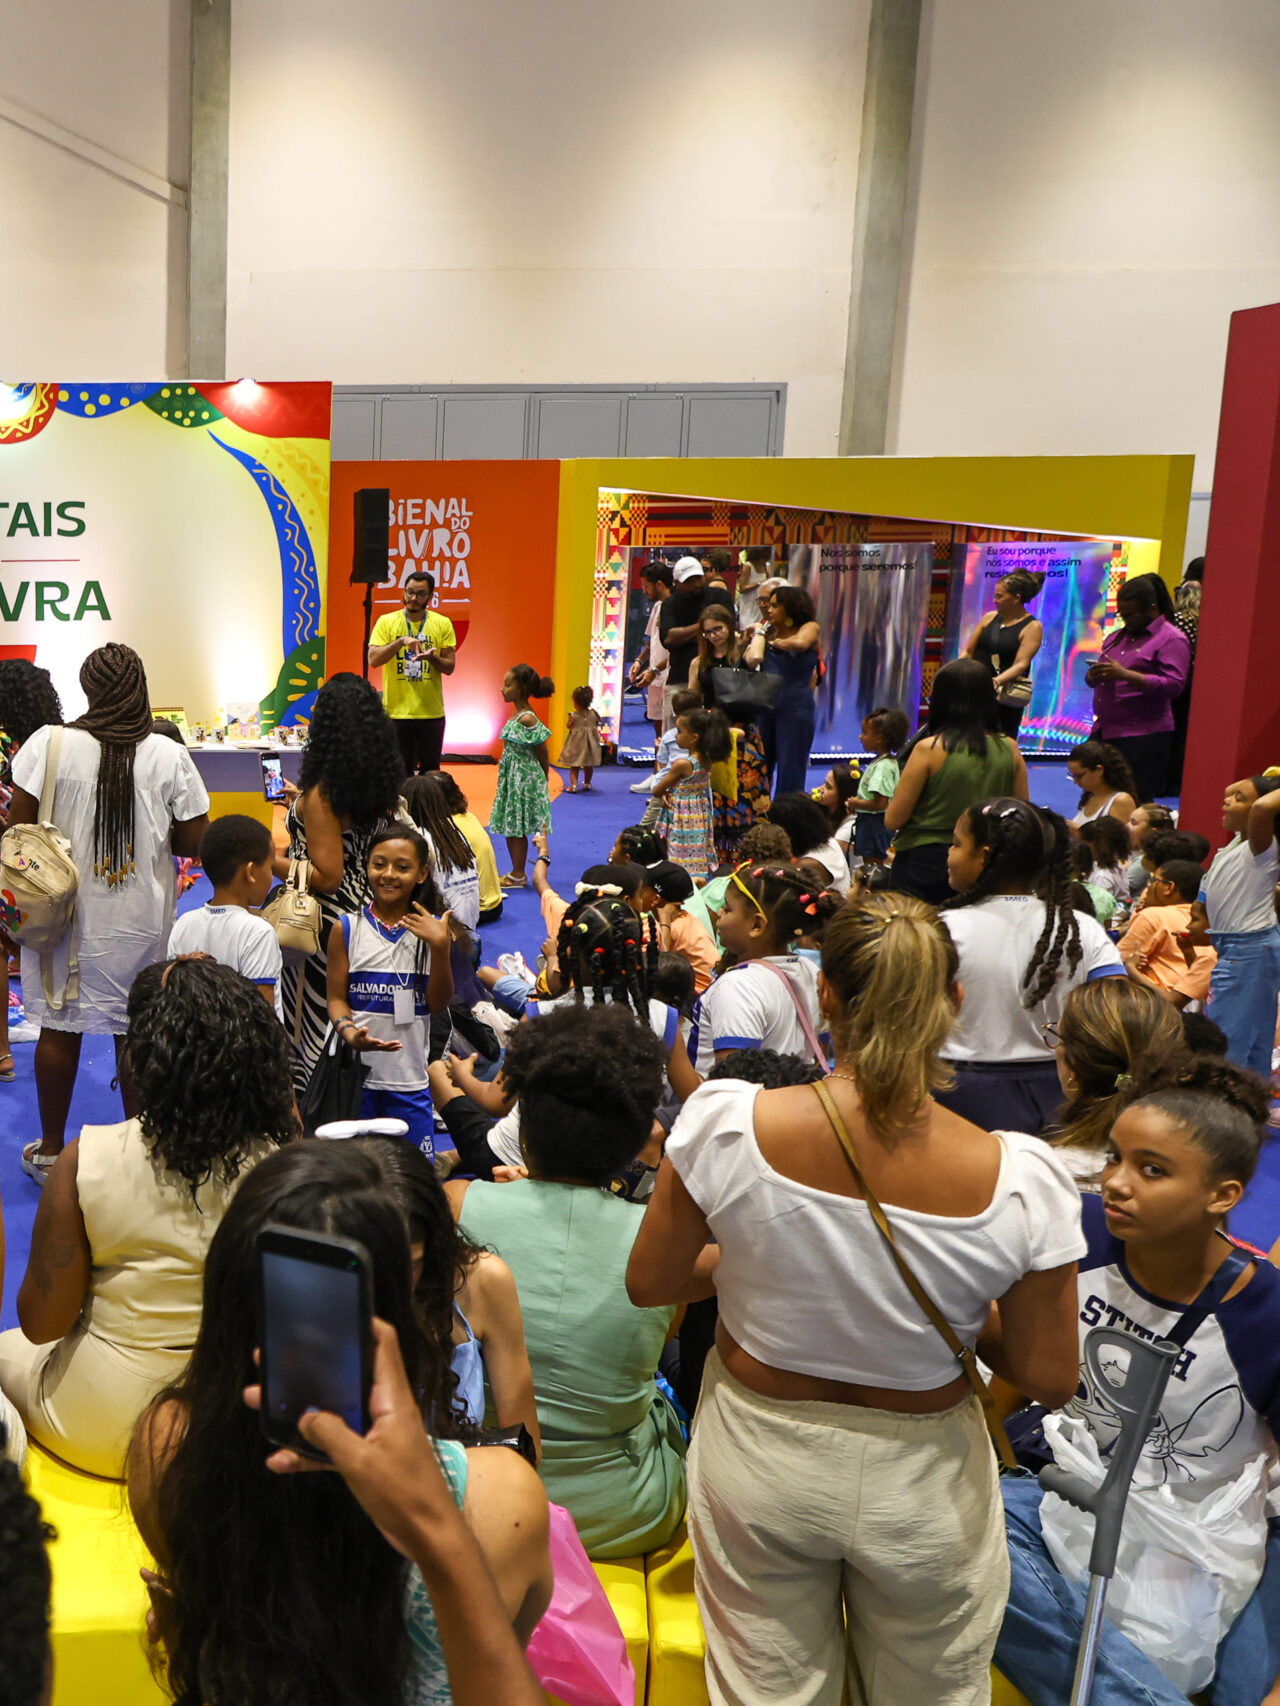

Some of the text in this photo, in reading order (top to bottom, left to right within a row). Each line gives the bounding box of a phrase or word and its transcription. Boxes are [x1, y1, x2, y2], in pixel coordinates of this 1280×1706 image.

[451, 517, 470, 532] DO
[987, 546, 1057, 558] Eu sou porque
[1002, 559, 1037, 567] somos
[1047, 557, 1082, 567] assim
[819, 564, 859, 574] porque
